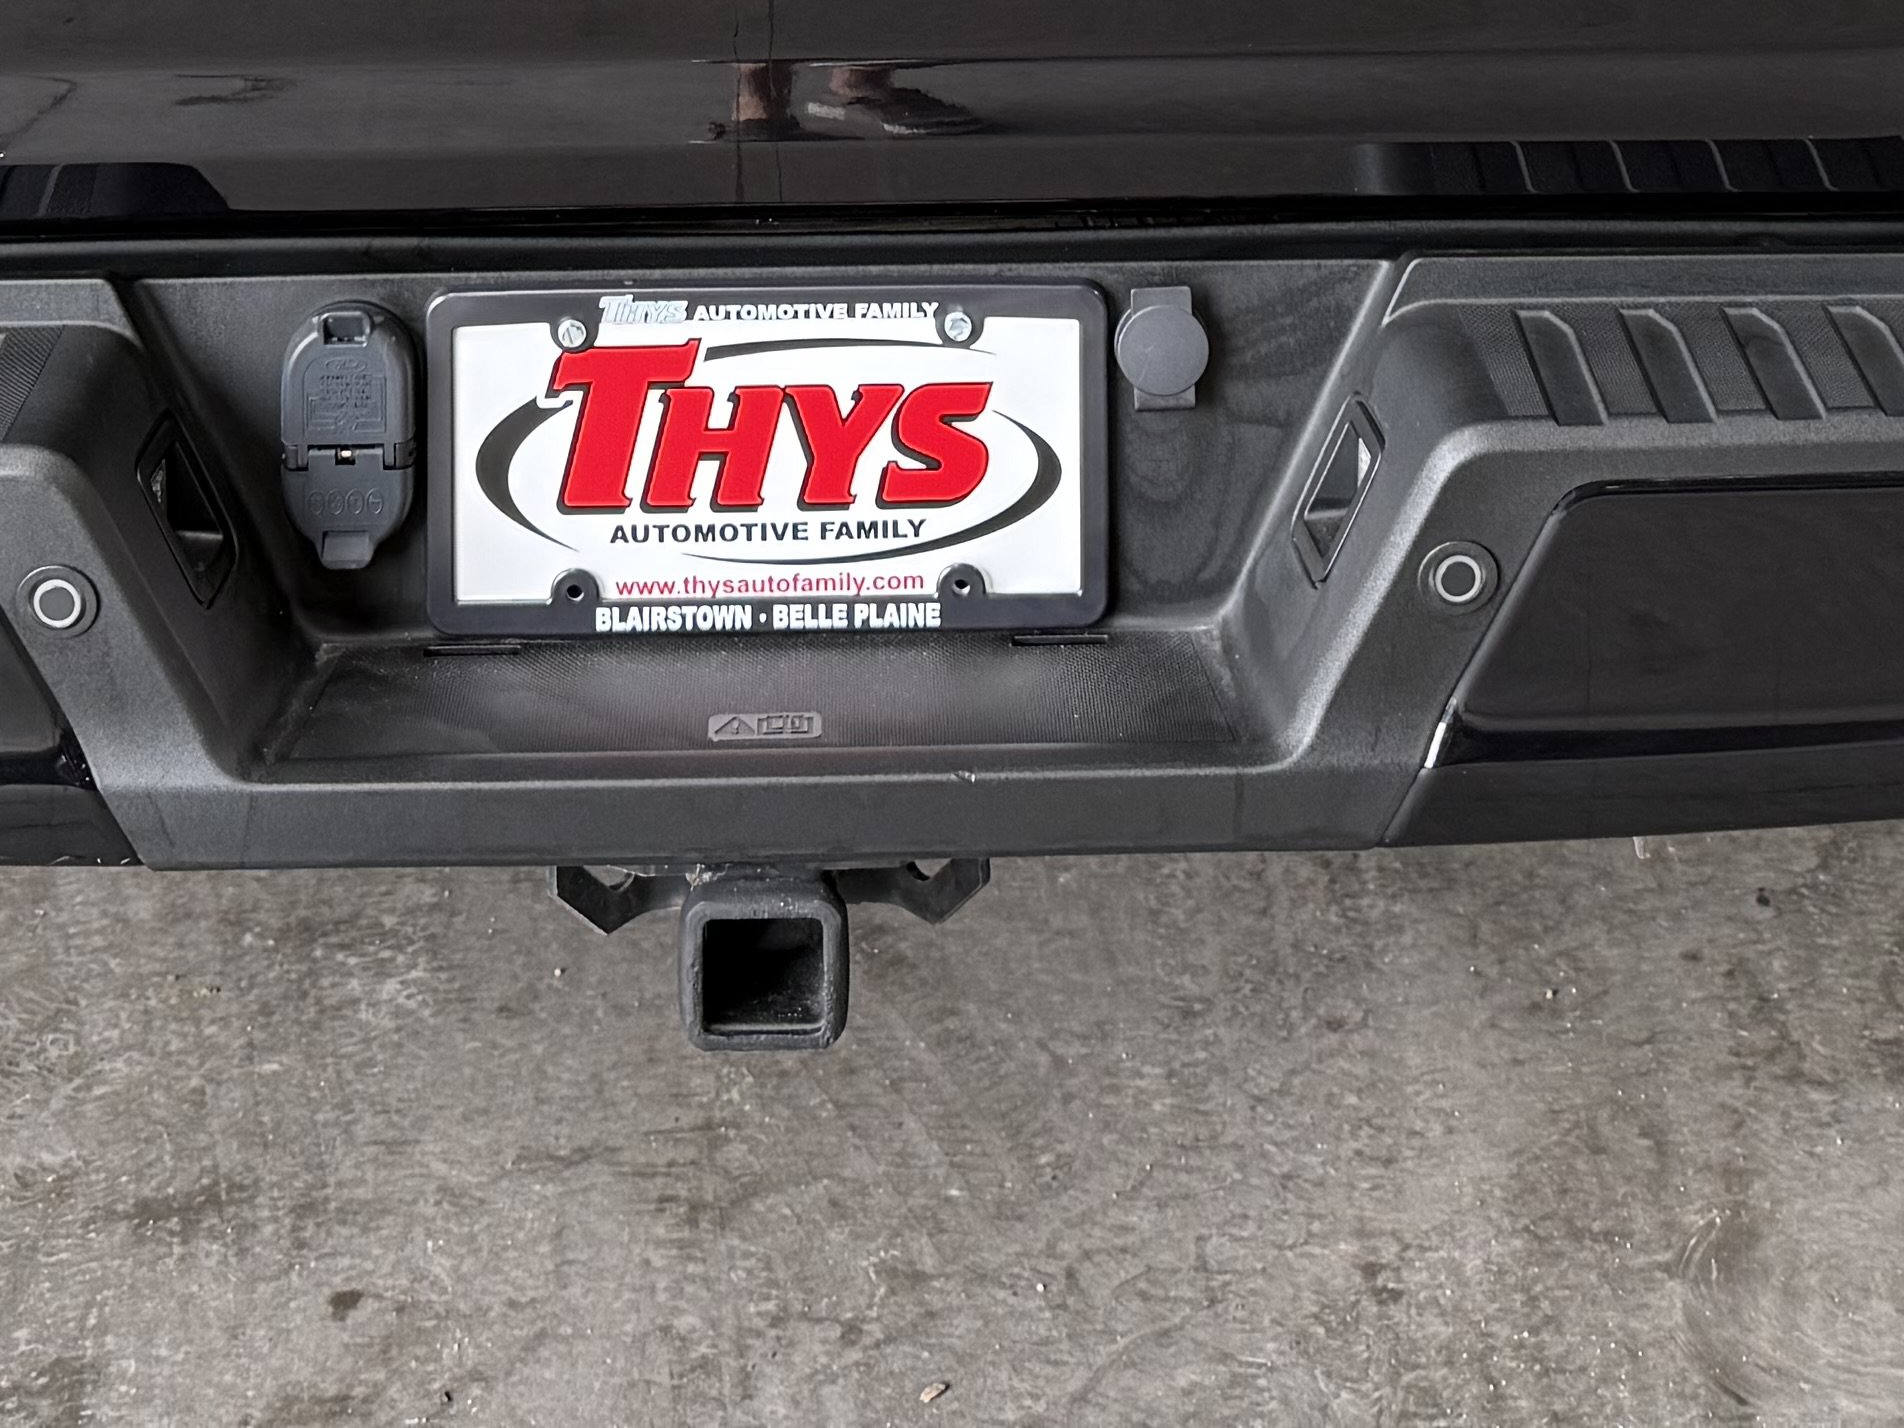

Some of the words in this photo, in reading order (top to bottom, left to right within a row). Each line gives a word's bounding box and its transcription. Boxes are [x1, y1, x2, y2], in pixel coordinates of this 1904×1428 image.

[598, 294, 688, 324] THYS
[695, 303, 848, 322] AUTOMOTIVE
[855, 301, 940, 321] FAMILY
[546, 337, 994, 514] THYS
[610, 521, 808, 544] AUTOMOTIVE
[820, 518, 927, 540] FAMILY
[615, 571, 924, 598] www.thysautofamily.com
[595, 604, 753, 633] BLAIRSTOWN
[772, 602, 848, 630] BELLE
[853, 601, 942, 629] PLAINE
